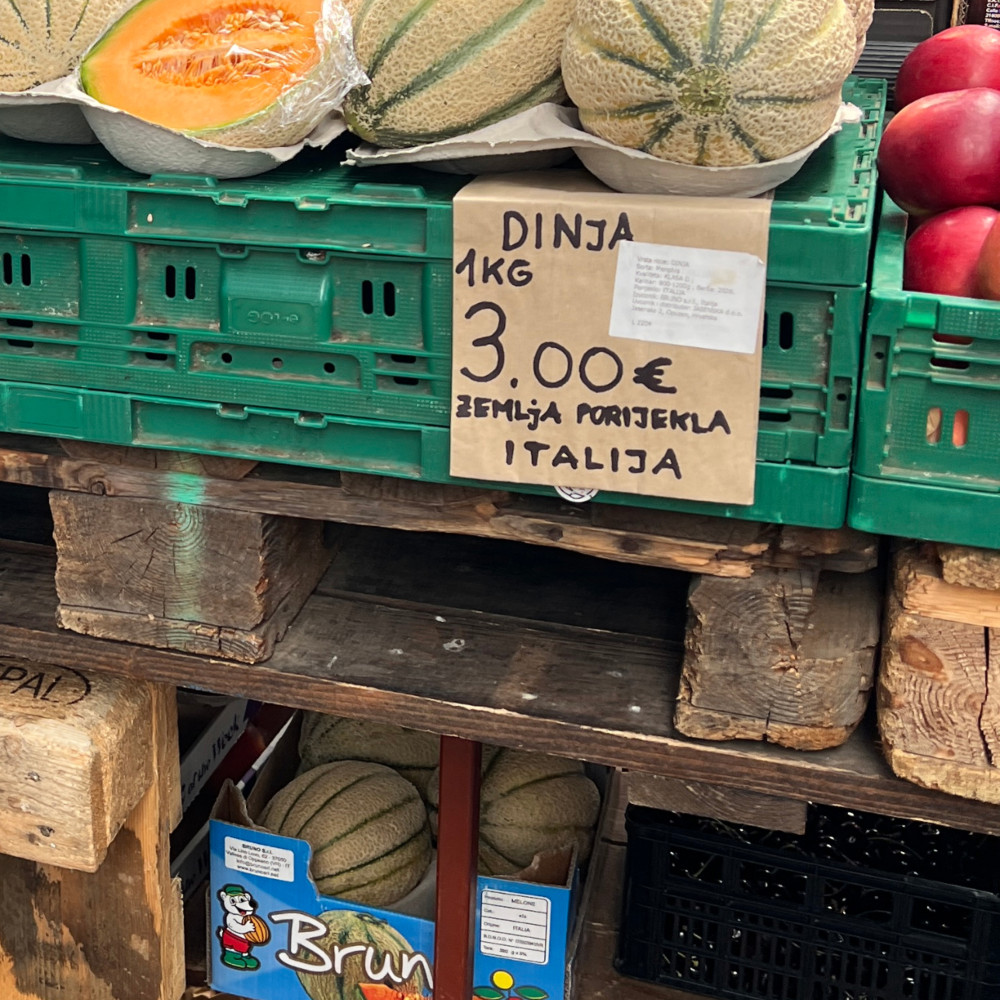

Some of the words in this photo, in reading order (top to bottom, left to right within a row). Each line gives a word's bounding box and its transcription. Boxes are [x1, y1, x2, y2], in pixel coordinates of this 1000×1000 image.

[502, 210, 634, 251] DINJA
[456, 248, 533, 287] 1KG
[576, 403, 732, 435] PORIJEKLA
[505, 440, 682, 480] ITALIJA
[270, 911, 434, 990] Brun
